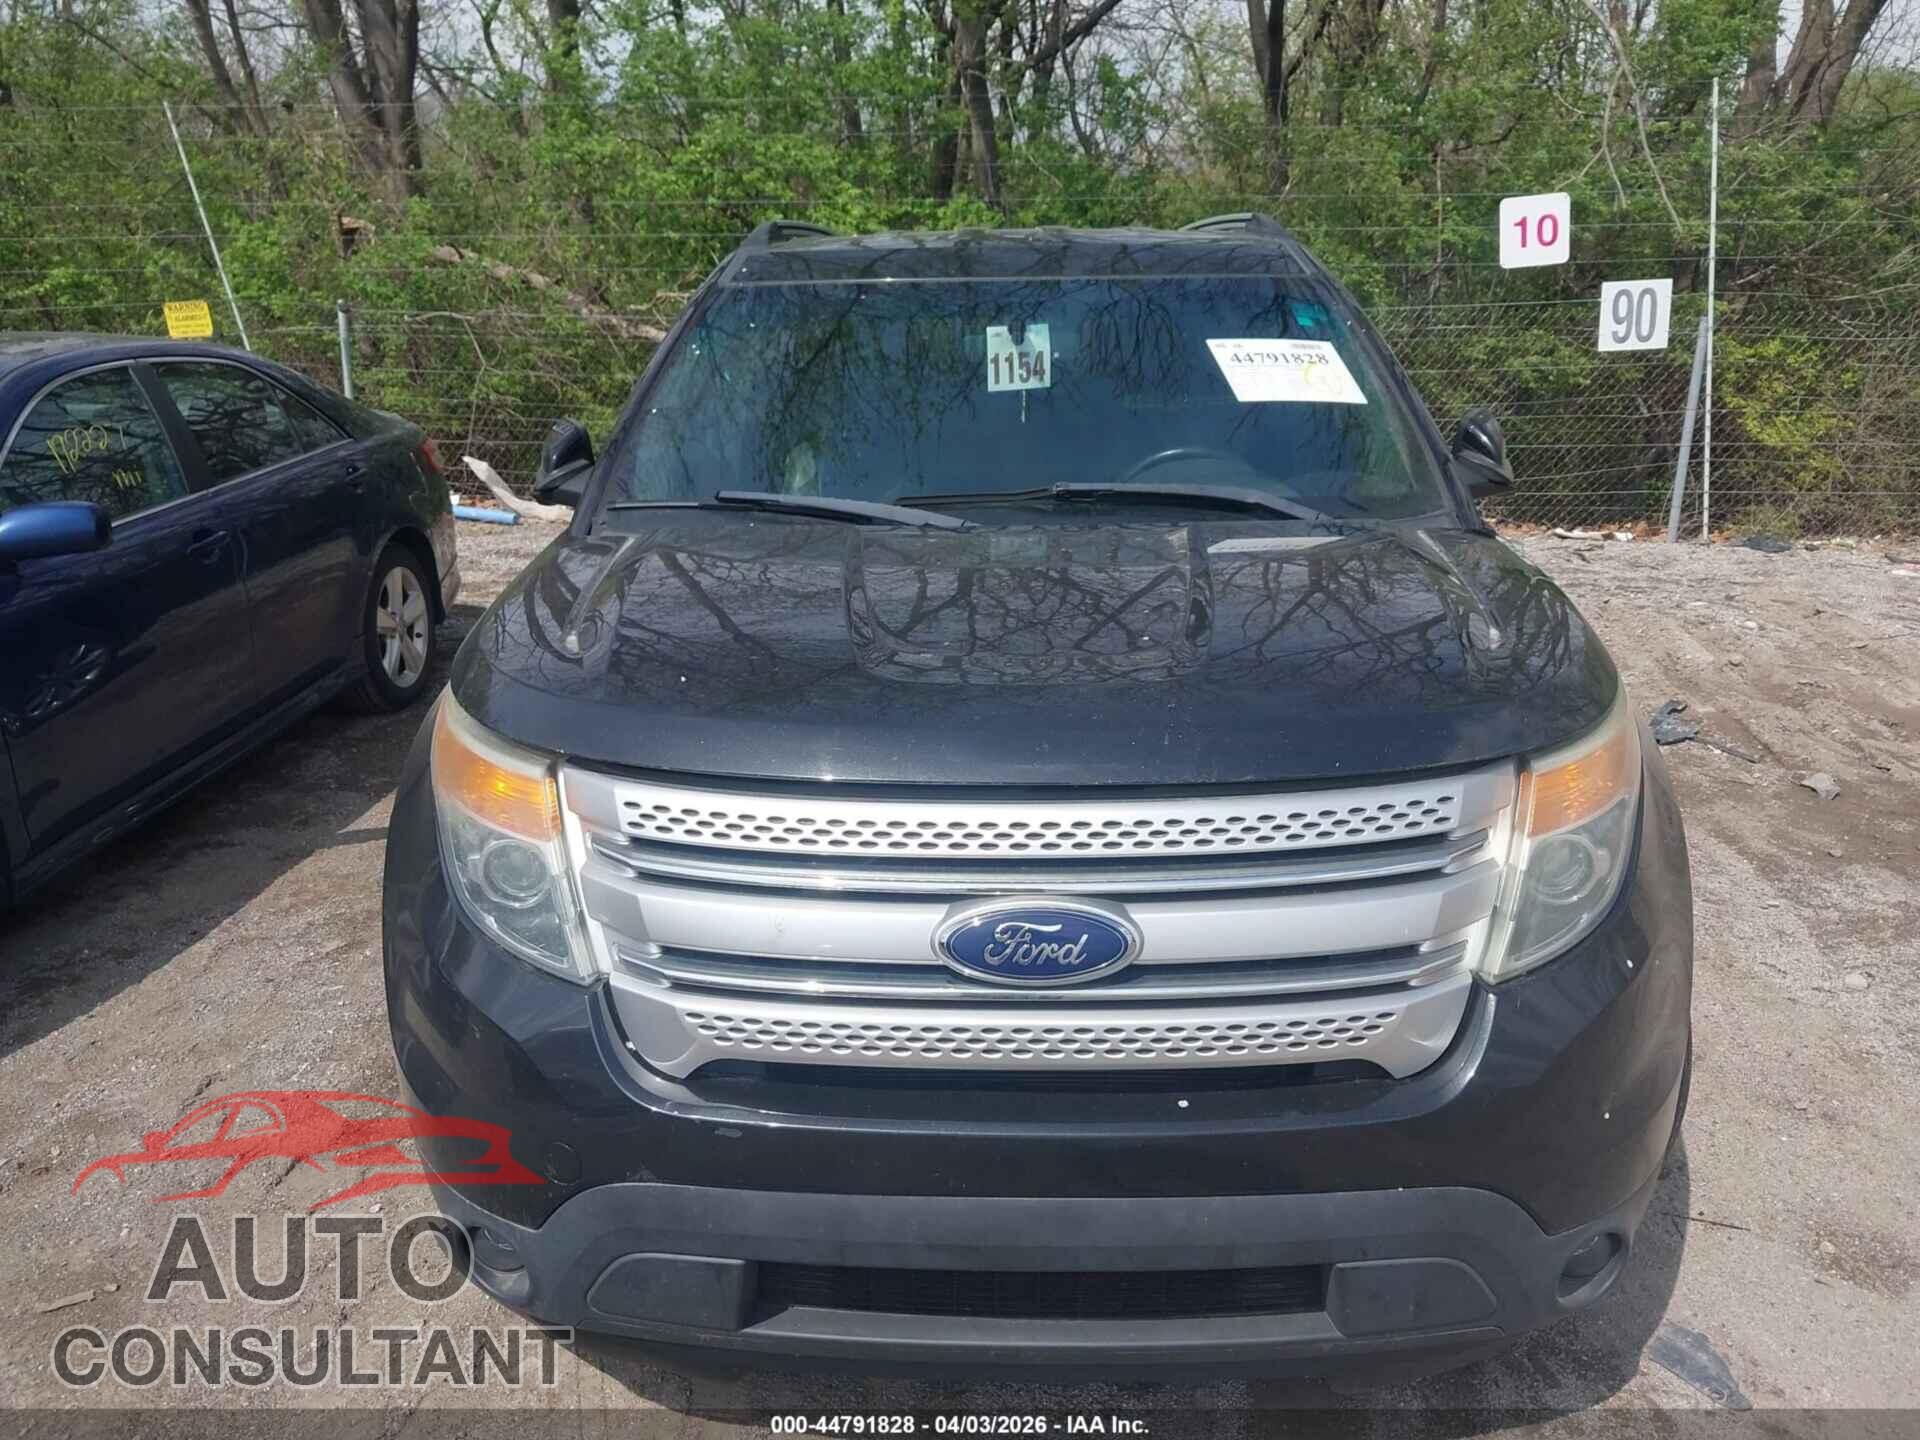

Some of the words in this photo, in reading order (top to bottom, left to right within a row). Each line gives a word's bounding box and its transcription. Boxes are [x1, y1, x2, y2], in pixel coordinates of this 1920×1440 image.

[1513, 214, 1559, 248] 10
[1612, 287, 1658, 344] 90
[990, 350, 1046, 385] 1154
[1230, 352, 1329, 365] 44791828
[983, 921, 1089, 966] Ford
